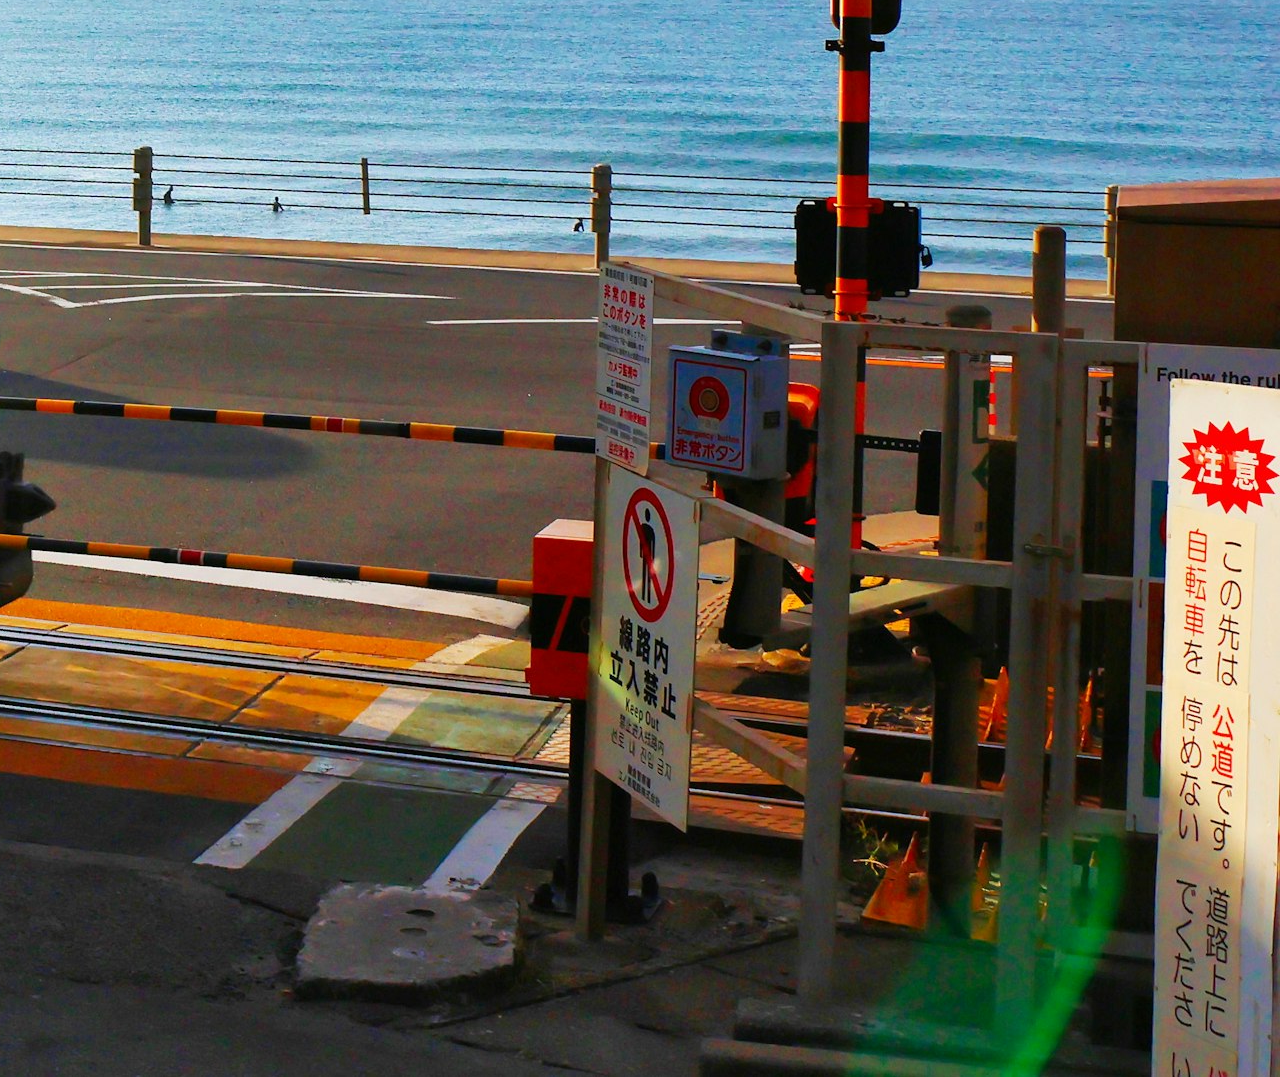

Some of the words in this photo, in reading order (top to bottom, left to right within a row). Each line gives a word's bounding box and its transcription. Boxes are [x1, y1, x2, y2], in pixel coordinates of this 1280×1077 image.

[602, 302, 646, 330] このボタンを
[603, 283, 646, 310] 非常の際は
[1156, 367, 1216, 382] Follow
[1221, 370, 1251, 385] the
[675, 439, 742, 462] 非常ボタン
[1197, 445, 1260, 491] 注意
[1183, 528, 1208, 676] 自転車を
[1216, 540, 1242, 687] この先は
[618, 614, 670, 675] 線路内
[609, 650, 677, 721] 立入禁止
[625, 696, 644, 722] Keep
[646, 713, 660, 733] Out
[656, 757, 672, 782] 금지
[1177, 695, 1204, 842] 停めない
[1210, 703, 1235, 870] 公道です。
[1204, 885, 1231, 1039] 道路上に
